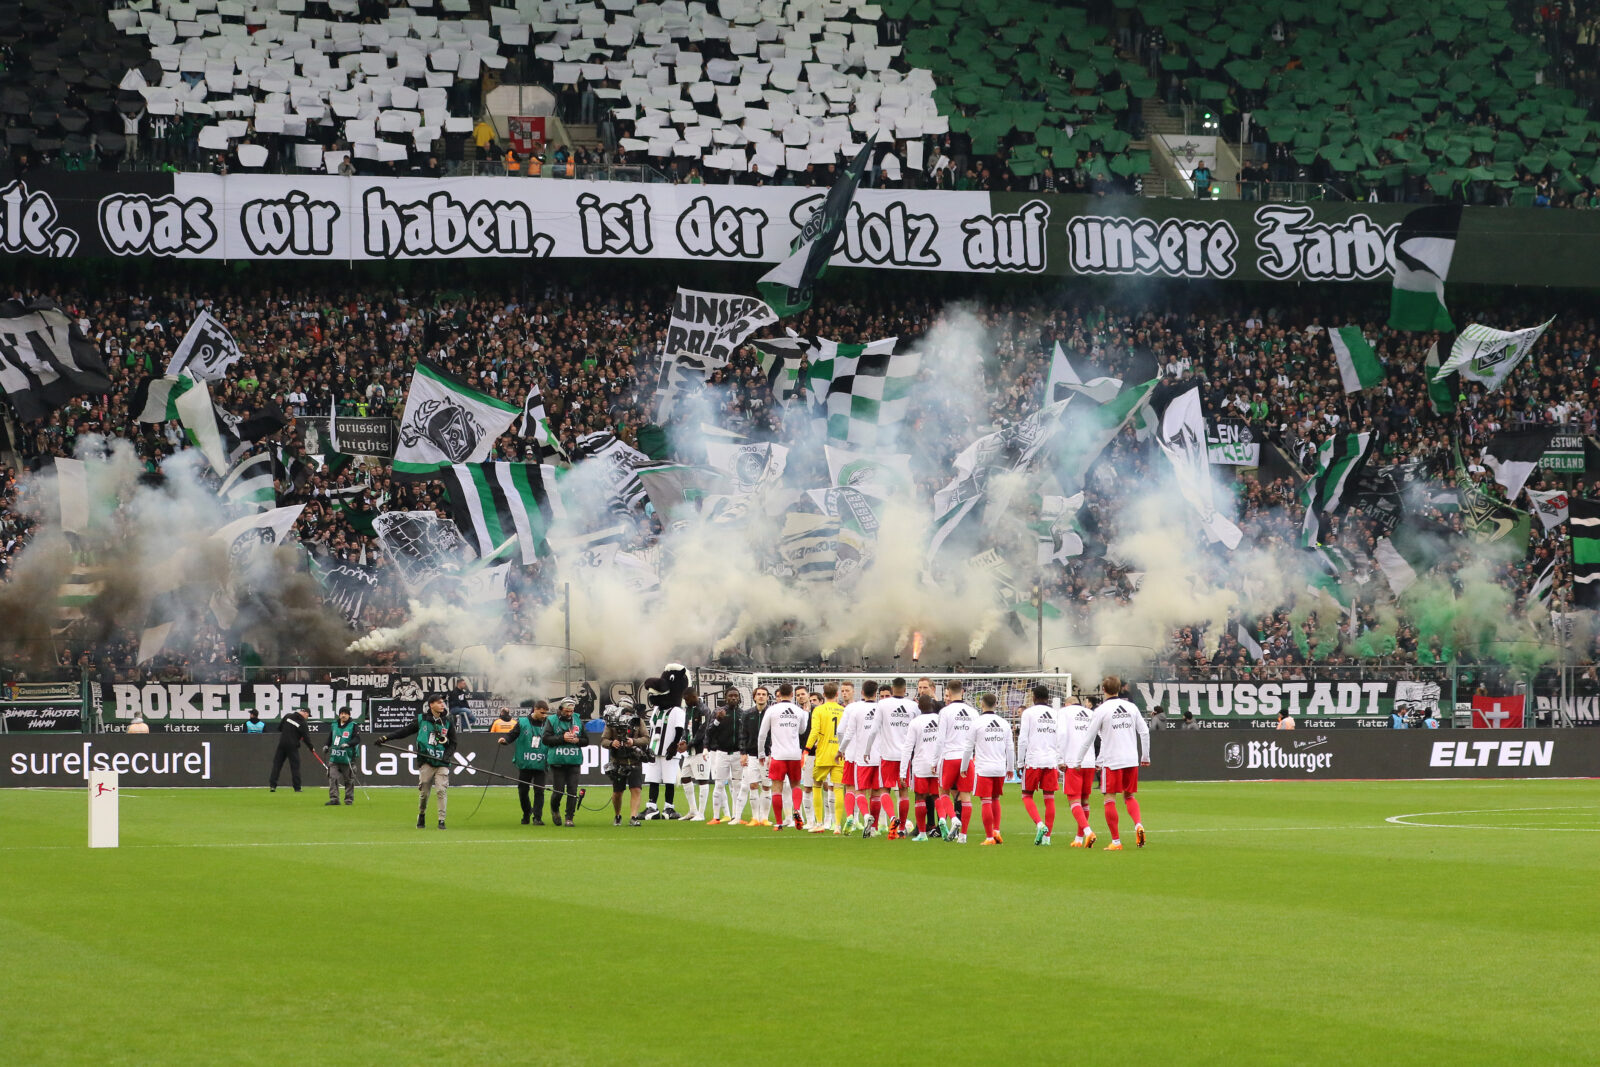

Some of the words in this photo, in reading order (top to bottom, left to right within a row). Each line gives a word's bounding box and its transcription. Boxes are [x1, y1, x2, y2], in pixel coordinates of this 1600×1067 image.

[98, 192, 219, 256] was
[240, 189, 341, 255] wir
[363, 185, 556, 259] haben,
[577, 191, 653, 254] ist
[677, 195, 769, 258] der
[962, 198, 1051, 275] auf
[1068, 213, 1239, 278] unsere
[1254, 204, 1398, 282] Farb
[338, 438, 389, 451] nights
[1548, 436, 1583, 448] ESTUNG
[1538, 457, 1584, 469] EGERLAND
[112, 680, 363, 720] BÖKELBERG
[1136, 682, 1388, 716] VITUSSTADT
[473, 708, 490, 716] BER
[164, 724, 200, 732] flatex
[831, 716, 838, 737] 1
[1197, 720, 1229, 728] flatex
[1304, 719, 1336, 728] flatex
[1357, 719, 1388, 728] flatex
[555, 747, 579, 756] HOST
[1246, 740, 1333, 773] Bitburger
[1430, 740, 1554, 767] ELTEN
[10, 742, 211, 780] sure[secure]
[697, 761, 705, 772] 10
